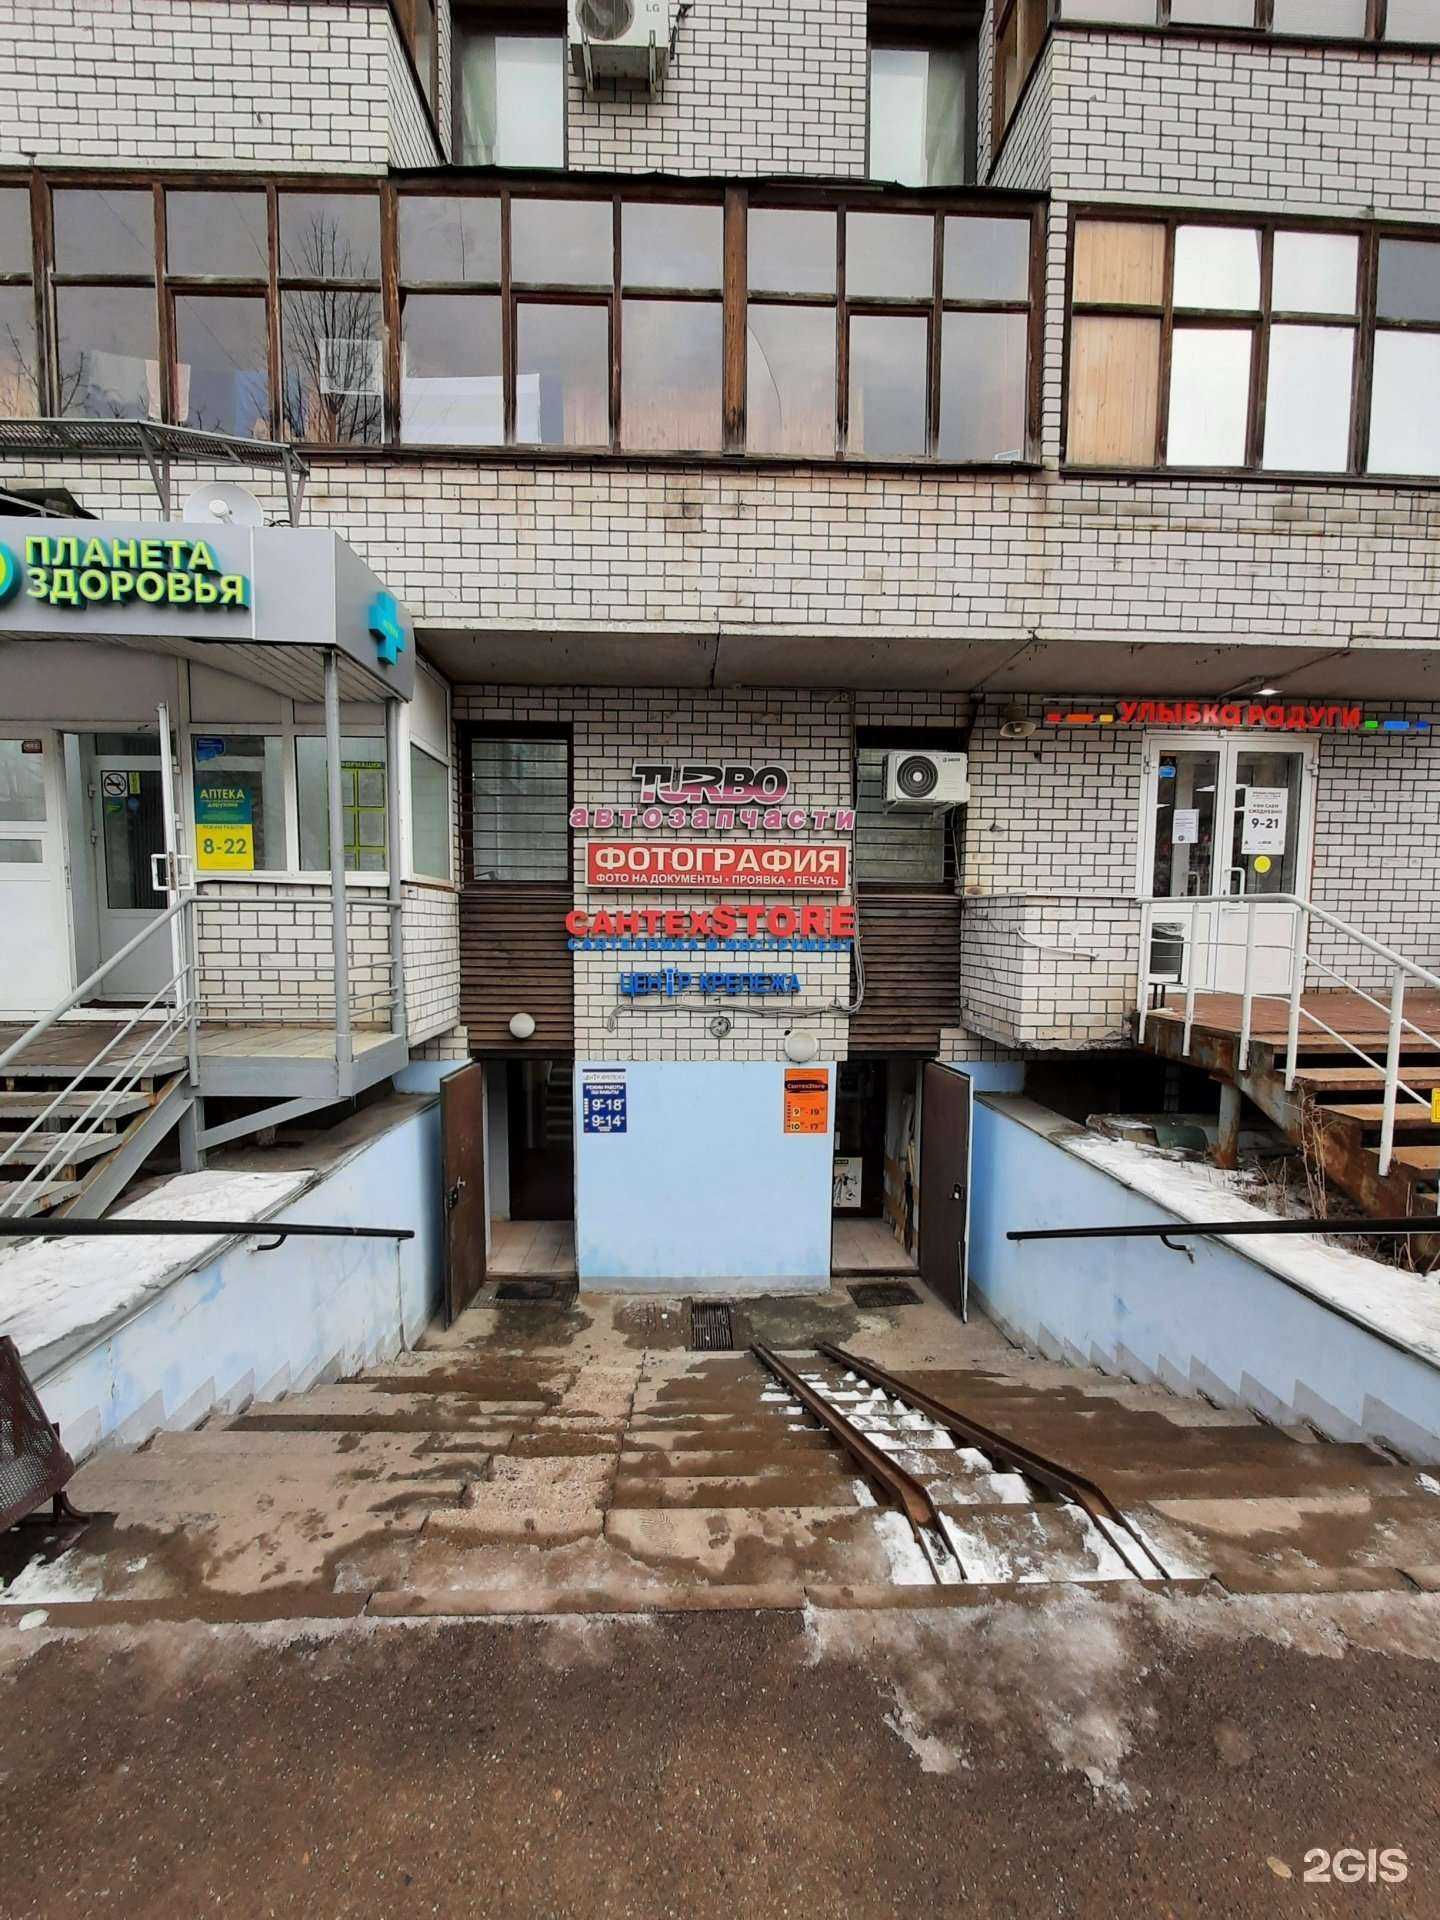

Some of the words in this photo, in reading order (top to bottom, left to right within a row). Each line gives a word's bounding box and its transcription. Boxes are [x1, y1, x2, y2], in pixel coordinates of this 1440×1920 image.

[646, 3, 660, 13] LG
[25, 535, 217, 572] ПЛАНЕТА
[26, 567, 246, 606] ЗДОРОВЬЯ
[200, 788, 245, 800] АПТЕКА
[632, 763, 790, 805] TURBO
[569, 807, 856, 831] автозапчасти
[1251, 817, 1279, 829] 9-21
[595, 846, 840, 873] ФОТОГРАФИЯ
[596, 874, 629, 883] ФОТО
[632, 874, 648, 883] НА
[650, 873, 723, 885] ДОКУМЕНТЫ
[732, 875, 785, 885] ПРОЯВКА
[794, 876, 839, 886] ПЕЧАТЬ
[620, 967, 692, 997] ЦЕНТР
[700, 971, 801, 994] КРЕПЕЖА
